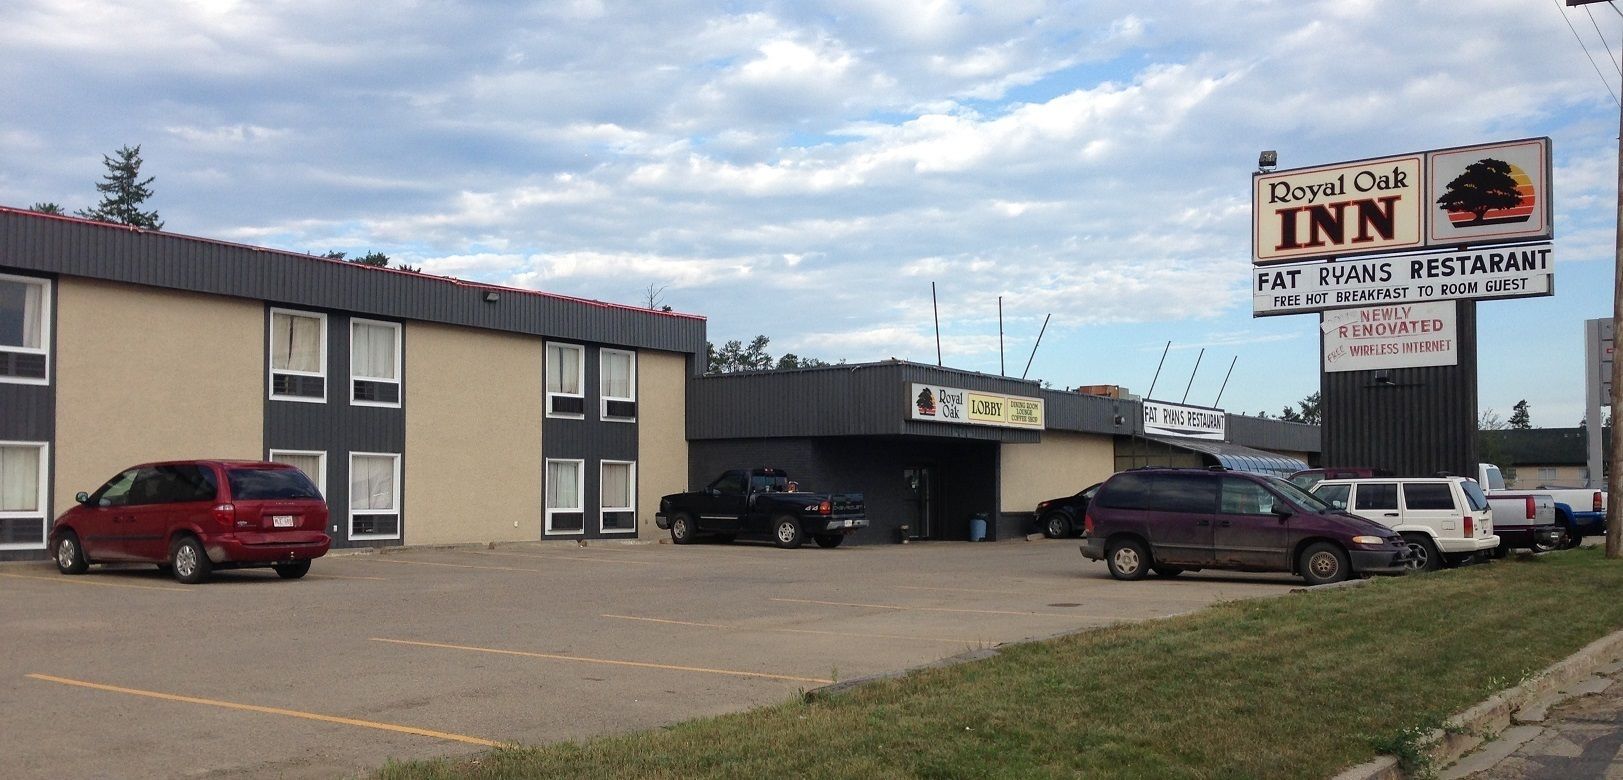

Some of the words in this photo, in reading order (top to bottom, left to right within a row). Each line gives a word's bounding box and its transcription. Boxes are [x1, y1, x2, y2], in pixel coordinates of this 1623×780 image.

[1268, 174, 1346, 204] Royal
[1353, 166, 1409, 193] Oak
[1275, 194, 1402, 252] INN
[1258, 269, 1302, 292] FAT
[1319, 262, 1393, 286] RYANS
[1410, 249, 1551, 279] RESTARANT
[1273, 295, 1301, 307] FREE
[1306, 292, 1329, 305] HOT
[1336, 287, 1410, 303] BREAKFAST
[1418, 285, 1434, 297] TO
[1441, 281, 1478, 296] ROOM
[1485, 277, 1529, 293] GUEST
[1360, 306, 1412, 322] NEWLY
[1339, 319, 1444, 339] RENOVATED
[1349, 343, 1399, 357] WIRELESS
[1402, 339, 1452, 354] INTERNET
[938, 388, 963, 408] Royal
[971, 399, 1003, 416] LOBBY
[942, 404, 960, 419] Oak
[1144, 405, 1158, 423] FAT
[1163, 408, 1185, 426] RYANS
[1187, 411, 1225, 430] RESTAURANT
